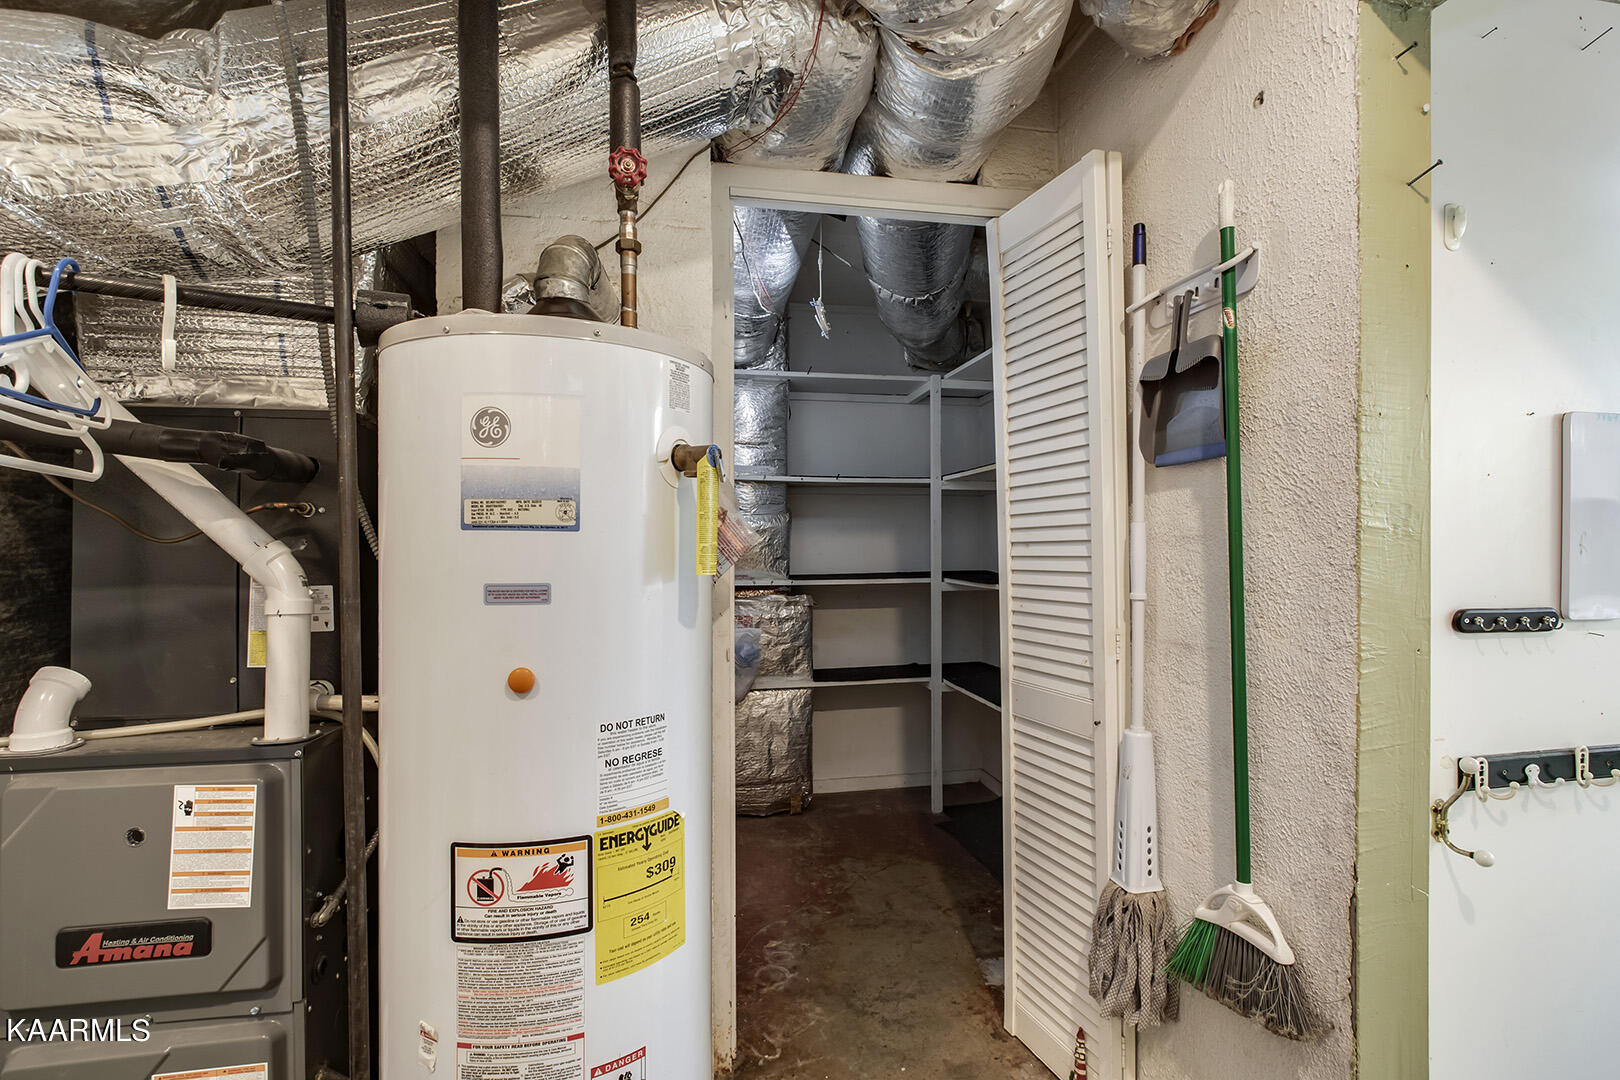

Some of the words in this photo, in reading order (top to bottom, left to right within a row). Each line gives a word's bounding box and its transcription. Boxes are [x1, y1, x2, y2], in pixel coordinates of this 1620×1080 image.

[600, 723, 613, 733] DO
[615, 719, 633, 731] NOT
[635, 713, 665, 727] RETURN
[604, 757, 619, 768] NO
[622, 747, 663, 764] REGRESE
[600, 804, 656, 824] 1-800-431-1549
[501, 847, 550, 857] WARNING
[646, 856, 676, 878] $309
[630, 912, 650, 927] 254
[69, 932, 193, 965] Amana
[102, 938, 130, 947] Heating
[150, 934, 194, 944] Conditioning
[542, 1038, 566, 1046] OPERATING
[605, 1050, 643, 1072] DANGER
